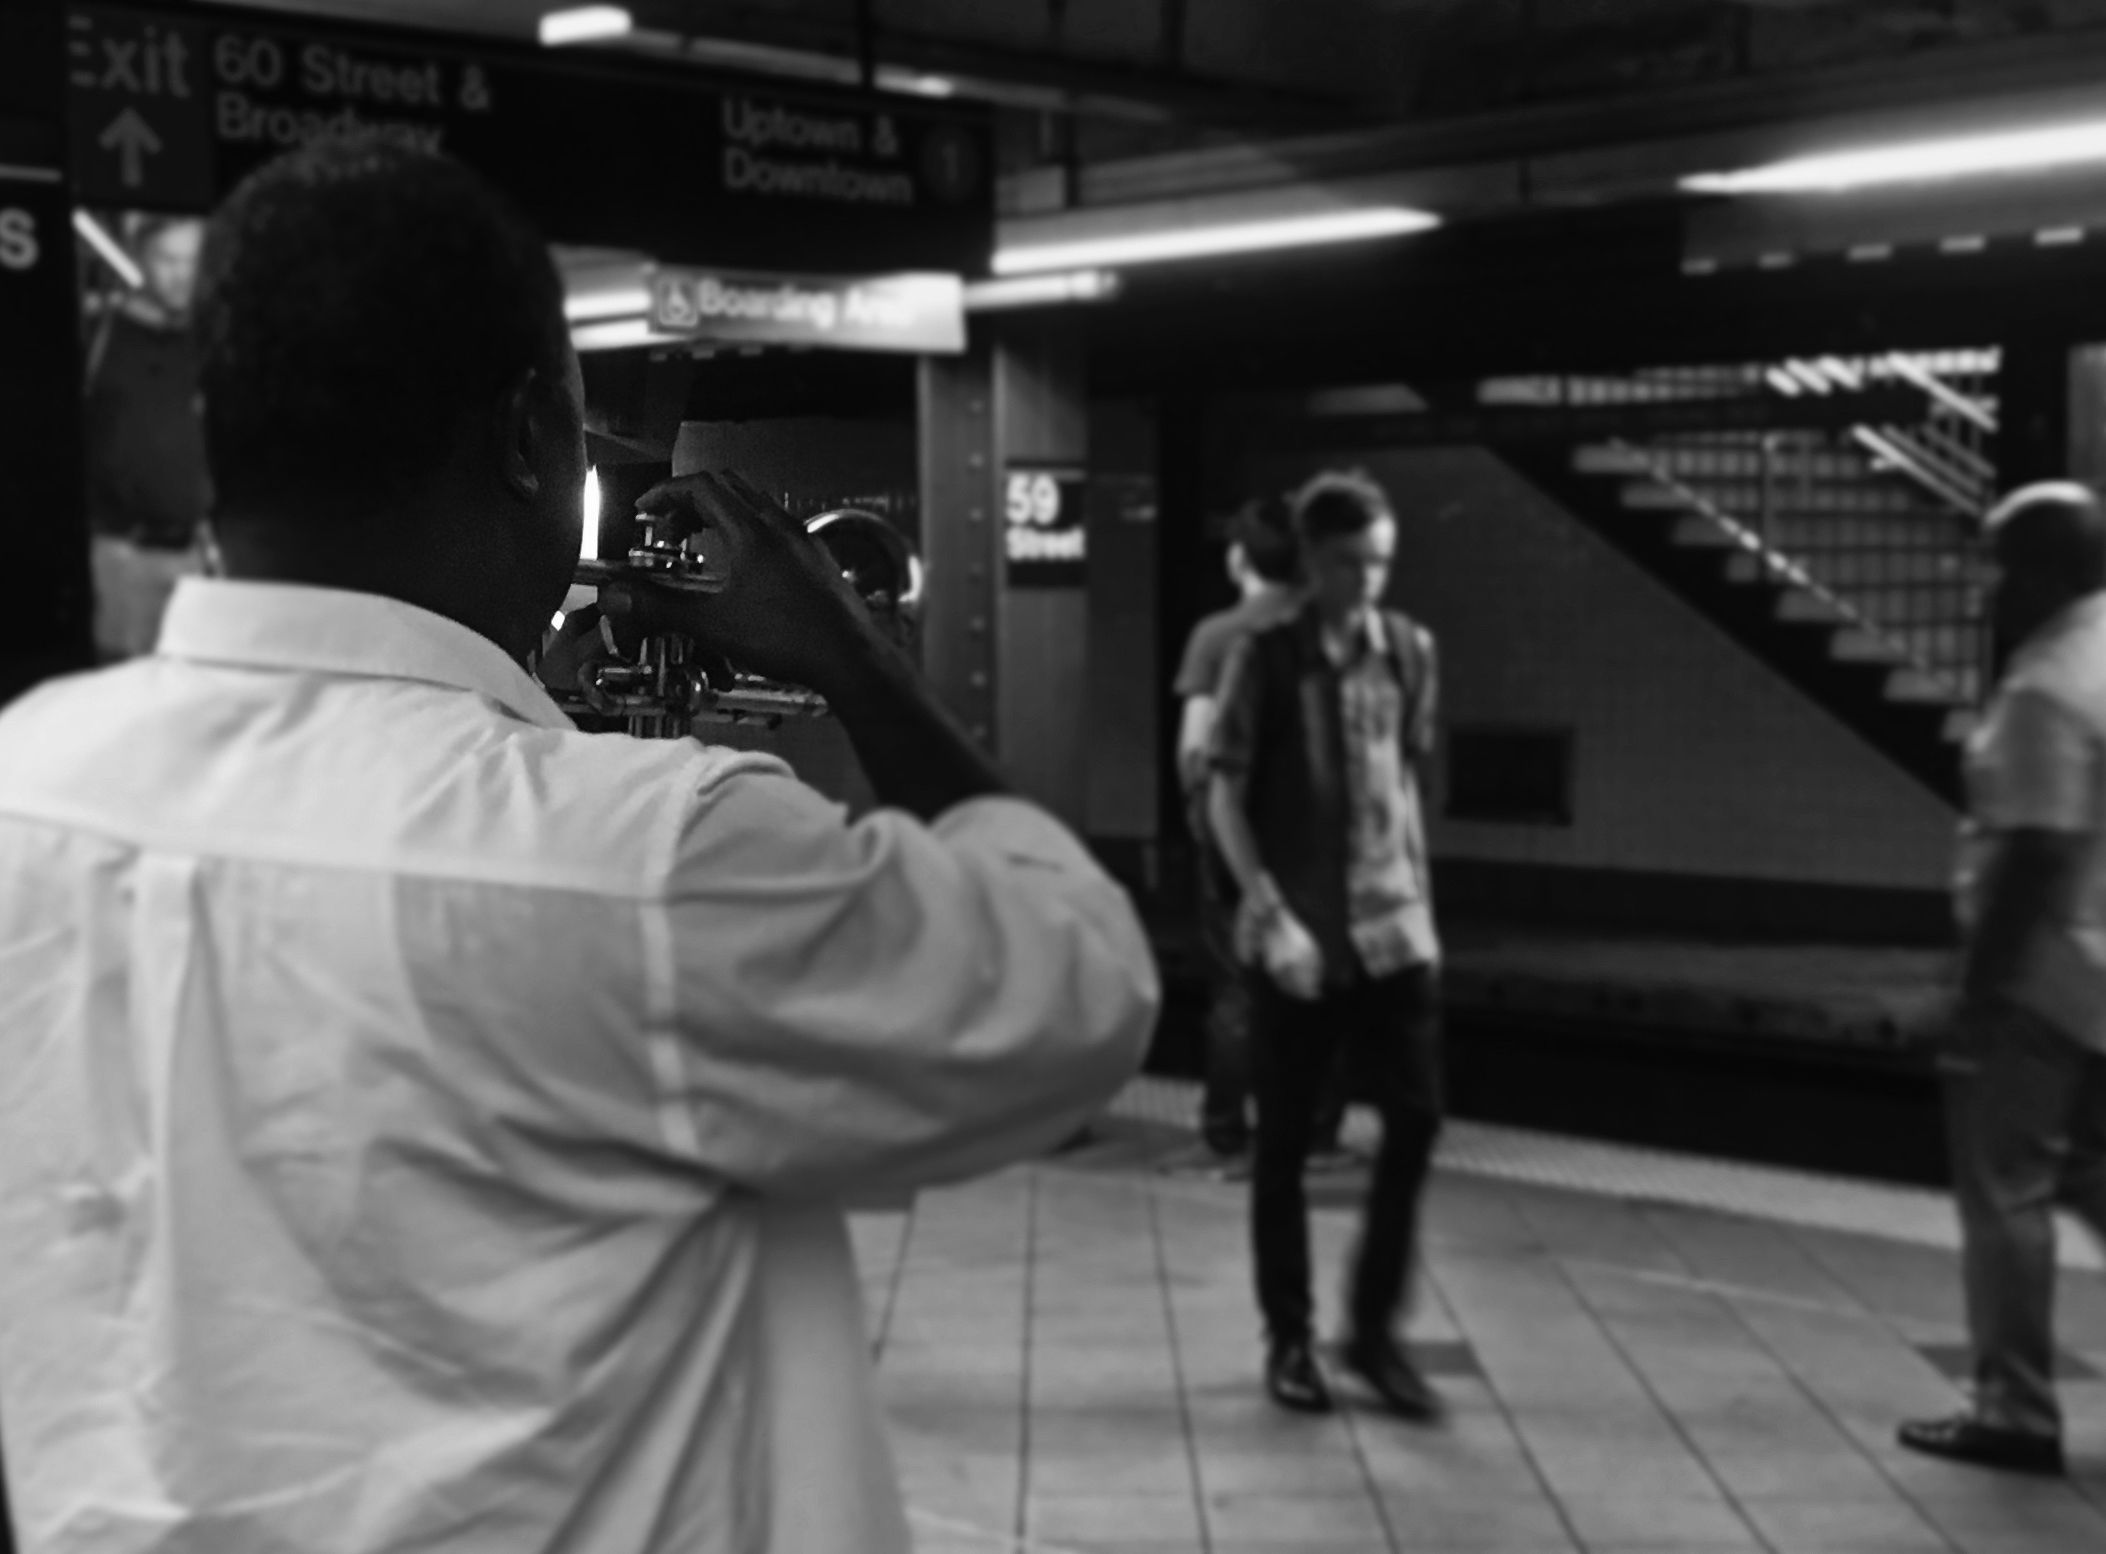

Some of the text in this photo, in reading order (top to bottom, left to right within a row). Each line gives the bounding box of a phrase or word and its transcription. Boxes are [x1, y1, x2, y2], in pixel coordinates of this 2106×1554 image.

[66, 14, 191, 99] Exit
[215, 33, 494, 112] 60 Street &
[722, 96, 898, 157] Uptown &
[722, 146, 914, 208] Downtown
[698, 278, 836, 331] Boarding
[1006, 472, 1058, 524] 59
